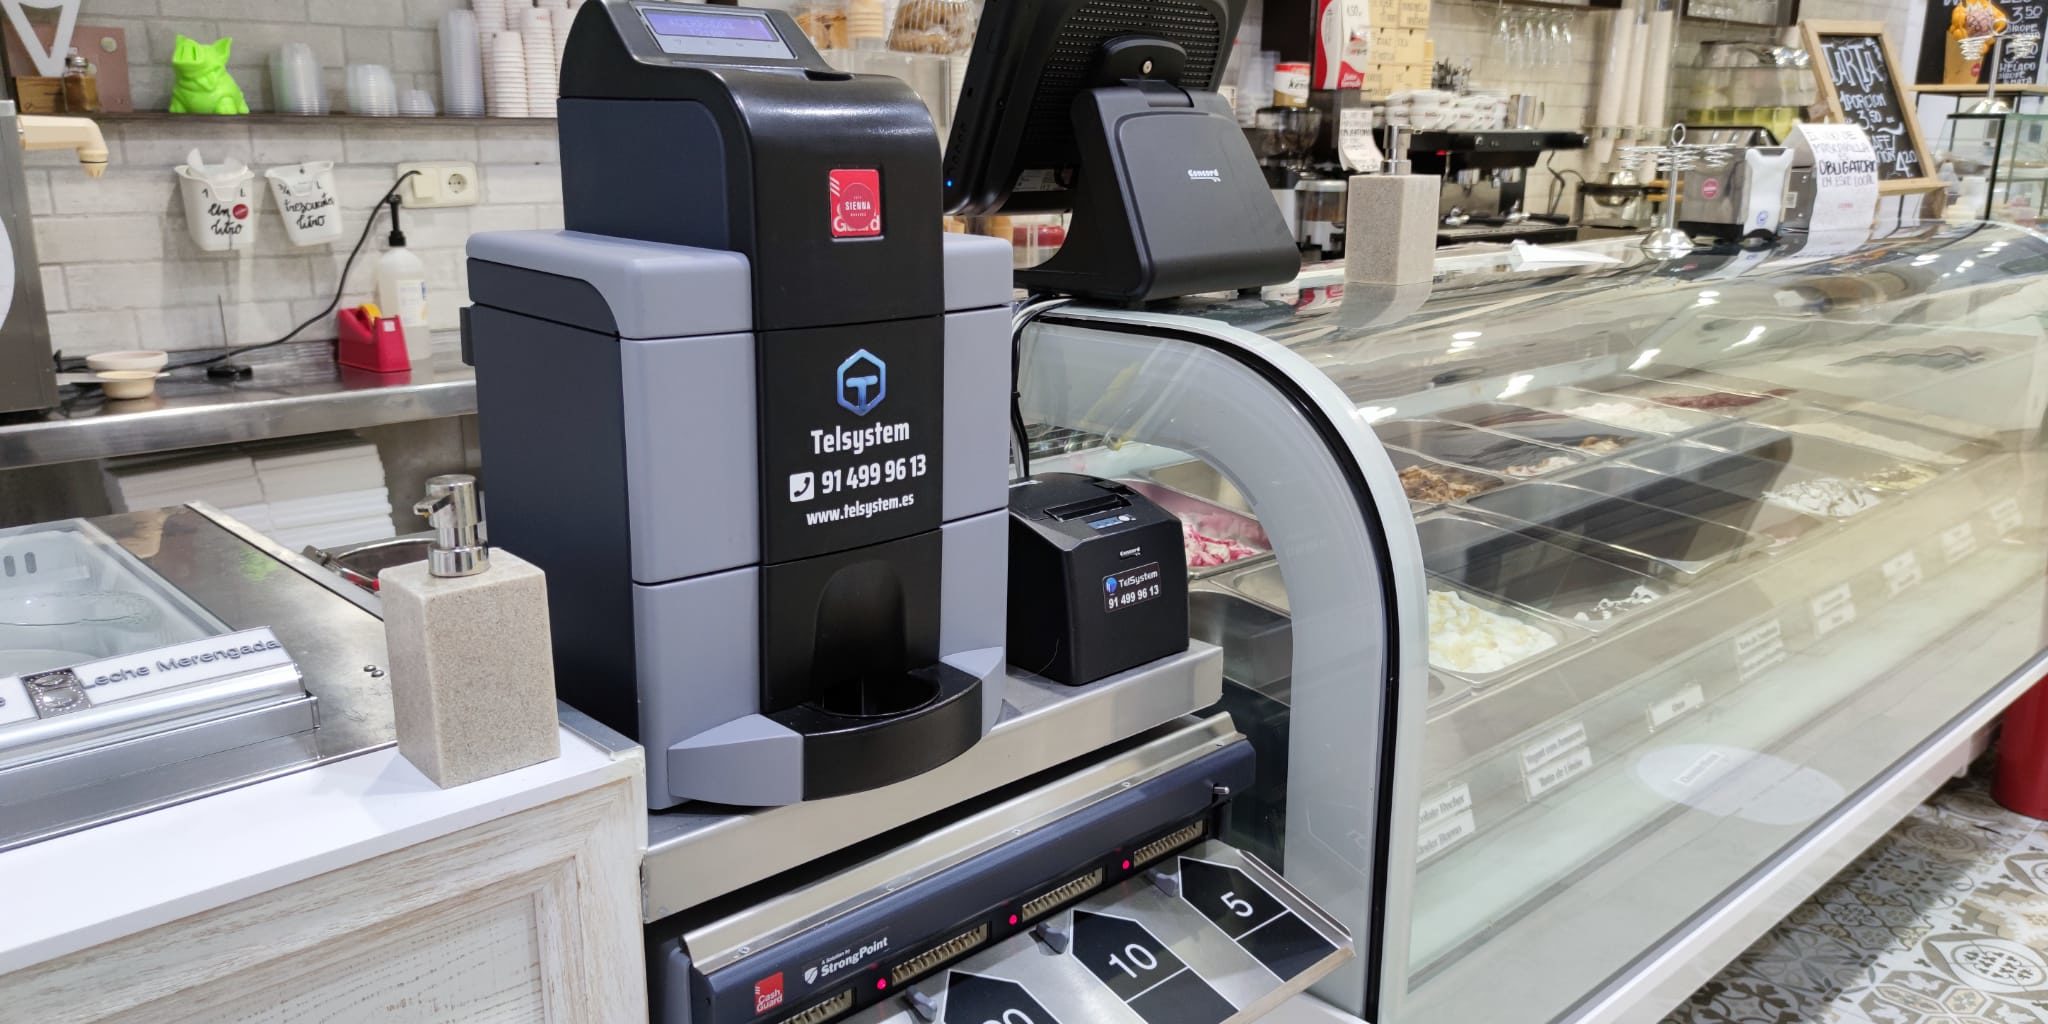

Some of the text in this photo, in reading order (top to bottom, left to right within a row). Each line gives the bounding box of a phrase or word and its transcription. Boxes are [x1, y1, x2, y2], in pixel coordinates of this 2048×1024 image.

[845, 200, 871, 211] SIENNA
[810, 421, 910, 455] Telsystem
[821, 453, 927, 495] 91 499 96 13
[806, 493, 915, 526] www.telsystem.es
[1118, 570, 1159, 589] TelSystem
[1108, 584, 1160, 609] 91 499 96 13
[80, 638, 282, 690] Leche Merengada
[1220, 890, 1254, 918] 5
[821, 936, 888, 978] StrongPoint
[1107, 942, 1159, 979] 10
[756, 993, 783, 1013] Guard
[759, 987, 781, 1003] Cash
